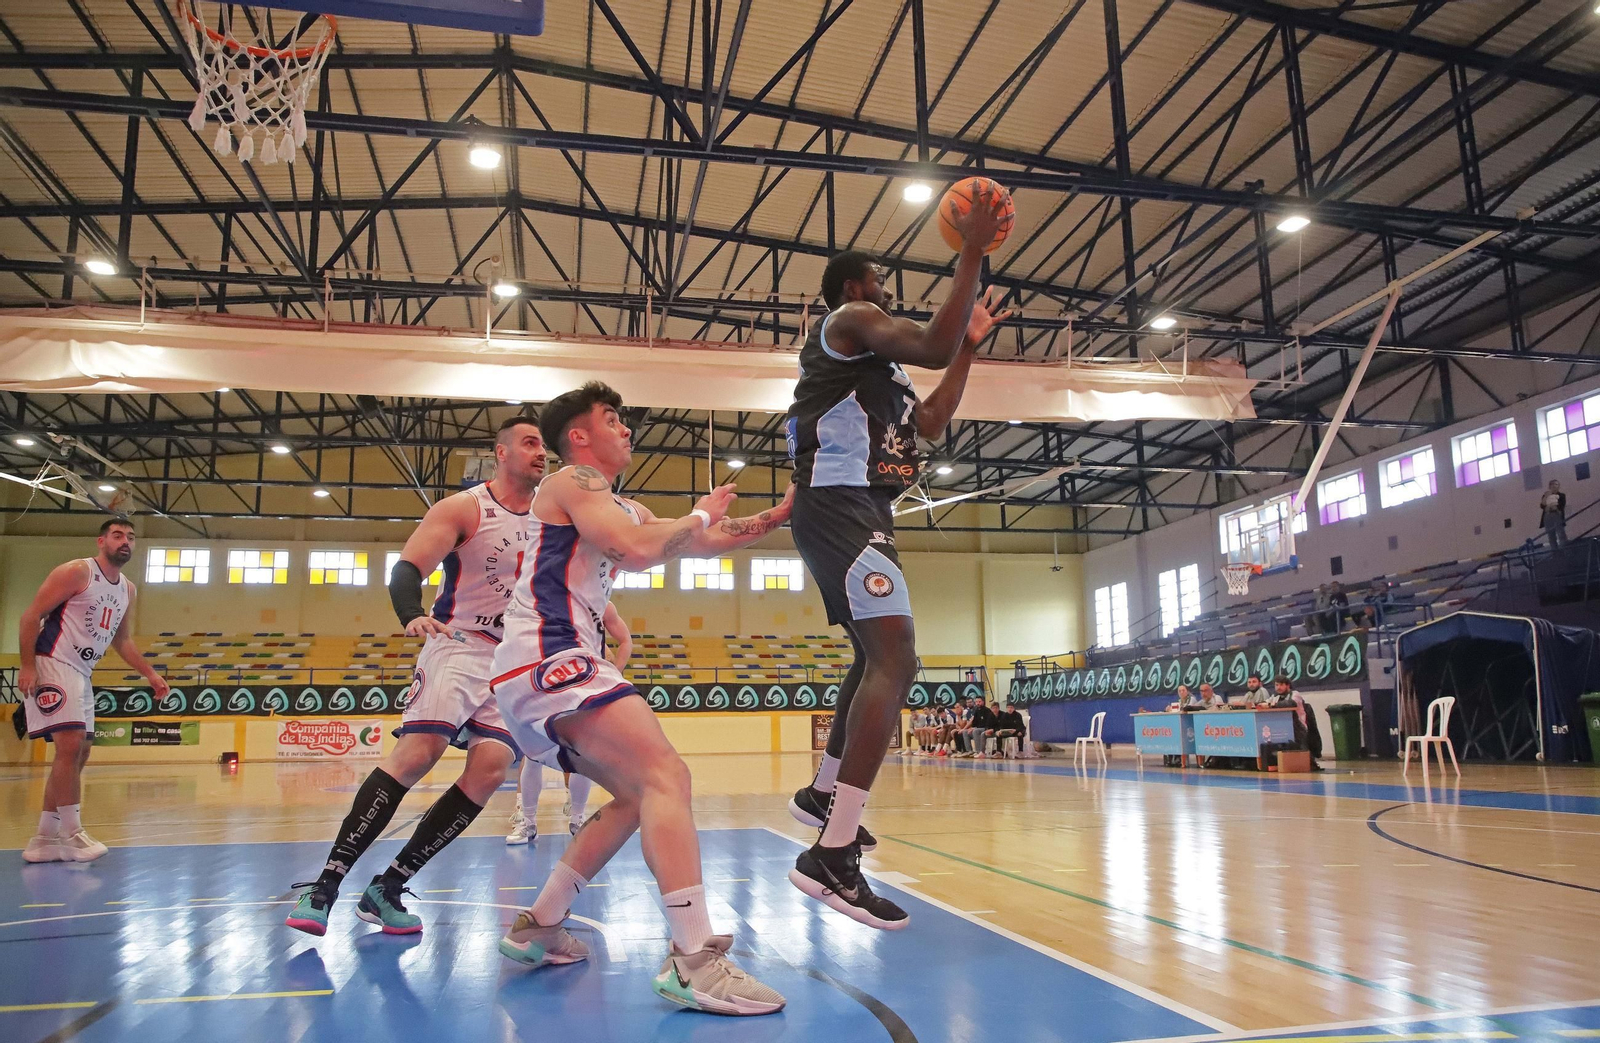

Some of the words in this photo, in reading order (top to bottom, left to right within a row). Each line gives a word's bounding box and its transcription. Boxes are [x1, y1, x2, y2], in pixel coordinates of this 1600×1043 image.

[901, 394, 915, 425] 7
[99, 606, 113, 630] 11
[475, 615, 493, 626] TU
[544, 659, 584, 686] CBLZ
[38, 693, 57, 706] CBLZ
[288, 721, 347, 735] Compañía
[1142, 724, 1173, 740] deportes
[1204, 723, 1245, 741] deportes
[281, 733, 296, 743] de
[298, 733, 315, 743] las
[317, 733, 354, 746] Indias
[346, 787, 389, 845] Kalenji
[424, 811, 470, 857] Kalenji
